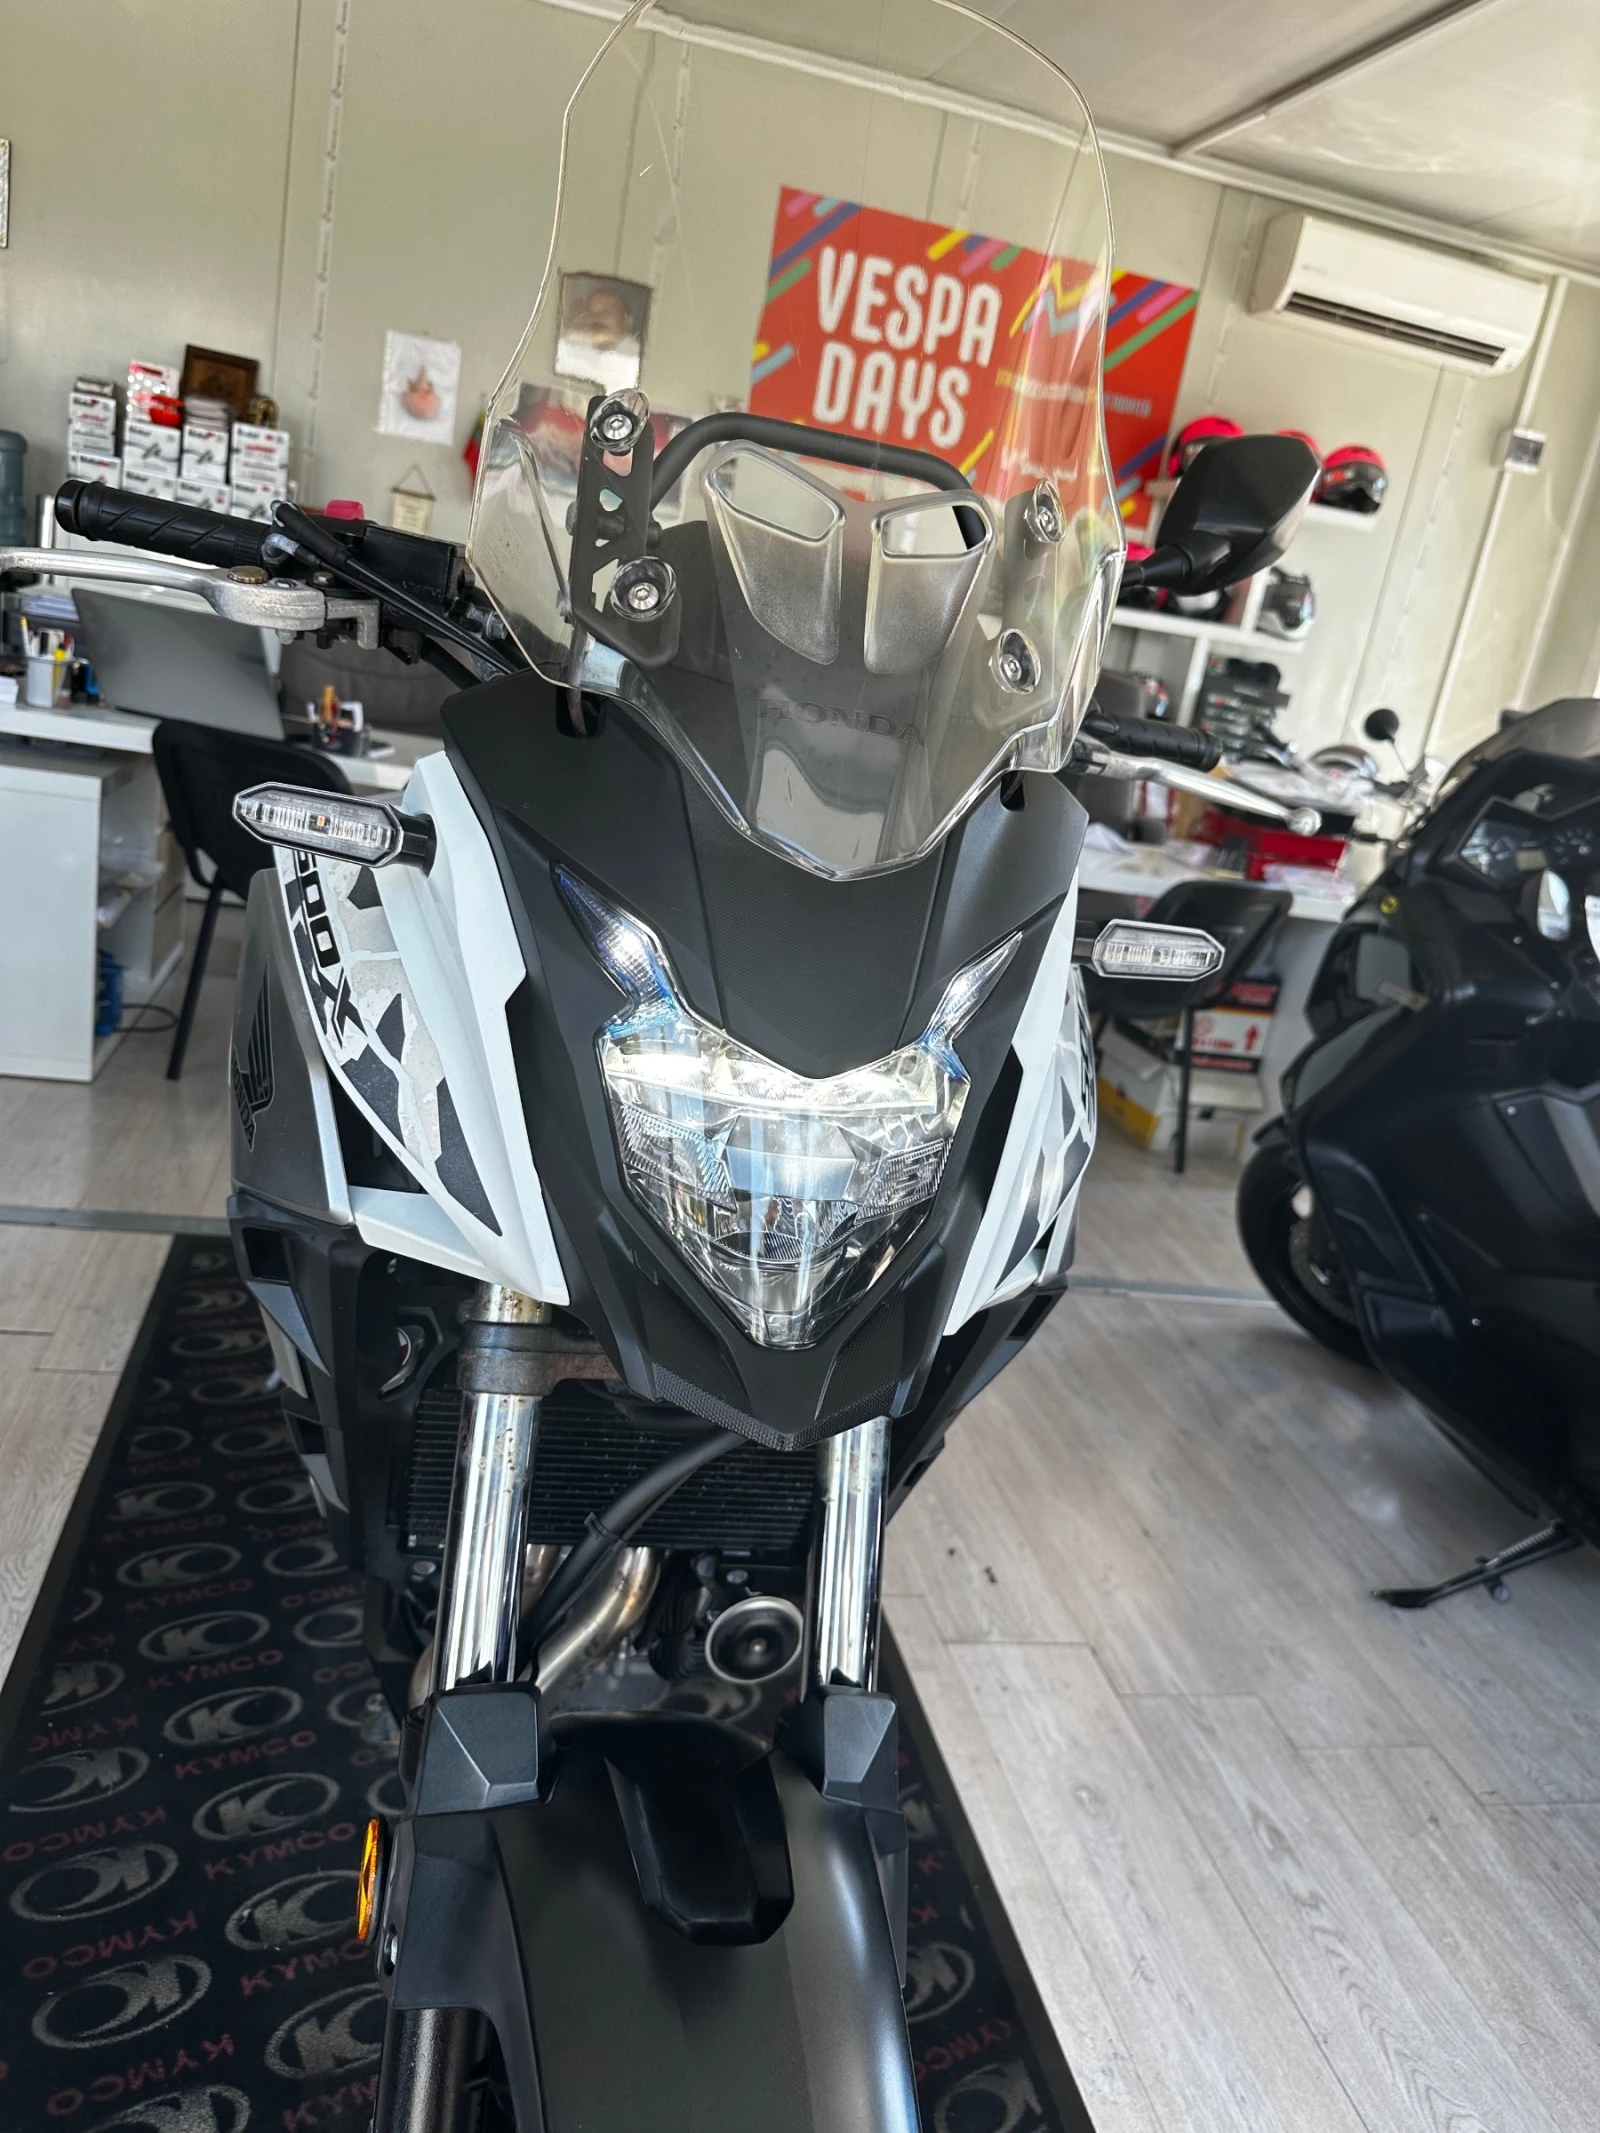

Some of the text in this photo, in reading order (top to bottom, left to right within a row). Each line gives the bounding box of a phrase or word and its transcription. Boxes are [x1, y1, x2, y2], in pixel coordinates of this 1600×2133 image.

[817, 246, 1002, 367] VESPA
[812, 341, 971, 449] DAYS
[130, 1456, 201, 1477] MCO
[125, 1578, 253, 1612] KYMCO
[147, 1649, 284, 1690] KYMCO
[30, 1713, 140, 1752] KYMC
[173, 1730, 318, 1779] KYMCO
[3, 1805, 167, 1862] KYMCO
[204, 1822, 358, 1880] KYMCO
[22, 1910, 198, 1979] KYMCO
[240, 1938, 374, 1997] KYMC
[46, 2032, 235, 2117] KYMCO
